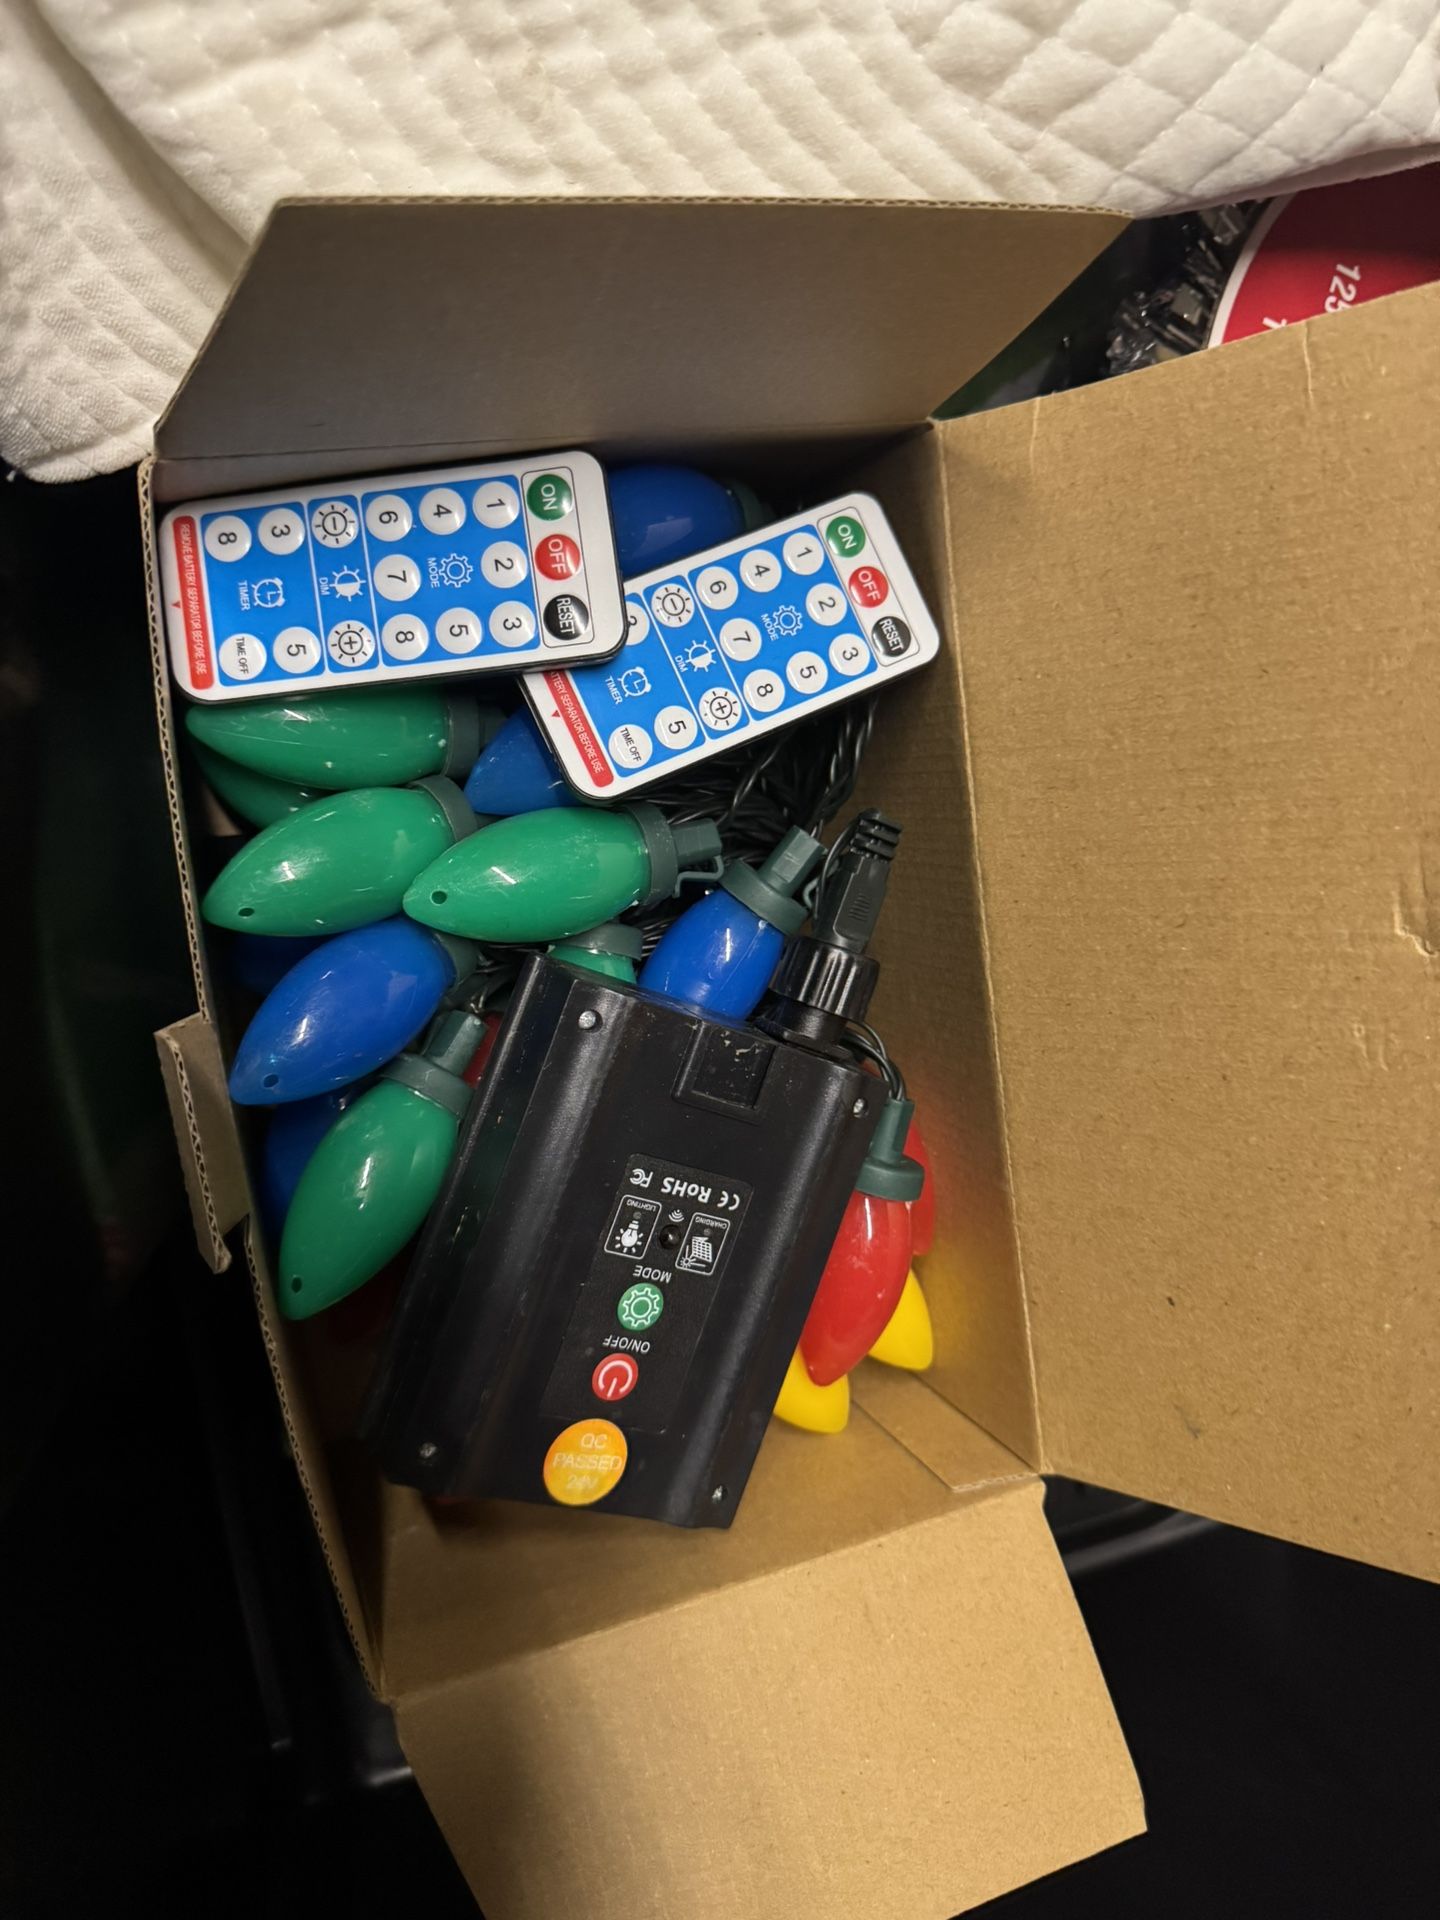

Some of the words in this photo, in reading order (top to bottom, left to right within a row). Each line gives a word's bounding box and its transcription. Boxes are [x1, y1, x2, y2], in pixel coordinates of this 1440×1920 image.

[486, 497, 505, 509] 1
[540, 483, 558, 511] ON
[378, 510, 398, 524] 6
[432, 504, 453, 518] 4
[218, 532, 238, 545] 8
[271, 524, 291, 537] 3
[837, 524, 856, 549] ON
[181, 524, 192, 554] REMOVE
[547, 538, 567, 574] OFF
[797, 547, 813, 560] 1
[185, 555, 197, 586] BATTERY
[425, 557, 440, 588] MODE
[495, 558, 514, 571] 2
[753, 563, 771, 578] 4
[387, 571, 407, 584] 7
[858, 570, 880, 601] OFF
[318, 576, 330, 596] DIM
[710, 581, 727, 595] 6
[237, 579, 250, 611] TIMER
[188, 588, 202, 629] SEPARATOR
[818, 597, 836, 612] 2
[503, 617, 523, 630] 3
[554, 598, 576, 635] RESET
[449, 624, 469, 637] 5
[760, 613, 778, 641] MODE
[879, 618, 904, 651] RESET
[193, 631, 205, 659] BEFORE
[395, 630, 415, 644] 8
[733, 630, 751, 644] 7
[235, 637, 247, 656] TIME
[287, 643, 307, 656] 5
[842, 646, 859, 661] 3
[197, 661, 207, 674] USE
[238, 658, 249, 674] OFF
[674, 655, 689, 673] DIM
[800, 665, 817, 680] 5
[605, 677, 623, 705] TIMER
[757, 684, 774, 697] 8
[549, 671, 565, 699] ATTERY
[562, 696, 585, 734] SEPARATOR
[578, 734, 595, 760] BEFORE
[590, 757, 602, 773] USE
[668, 720, 687, 734] 5
[620, 727, 634, 748] TIME
[629, 746, 642, 763] OFF
[661, 1177, 712, 1203] RoHS
[626, 1198, 657, 1211] LIGHTING
[695, 1215, 728, 1229] CHARGING
[633, 1265, 672, 1283] MODE
[603, 1335, 651, 1353] ON/OFF
[580, 1432, 608, 1449] QC
[552, 1452, 622, 1473] PASSED
